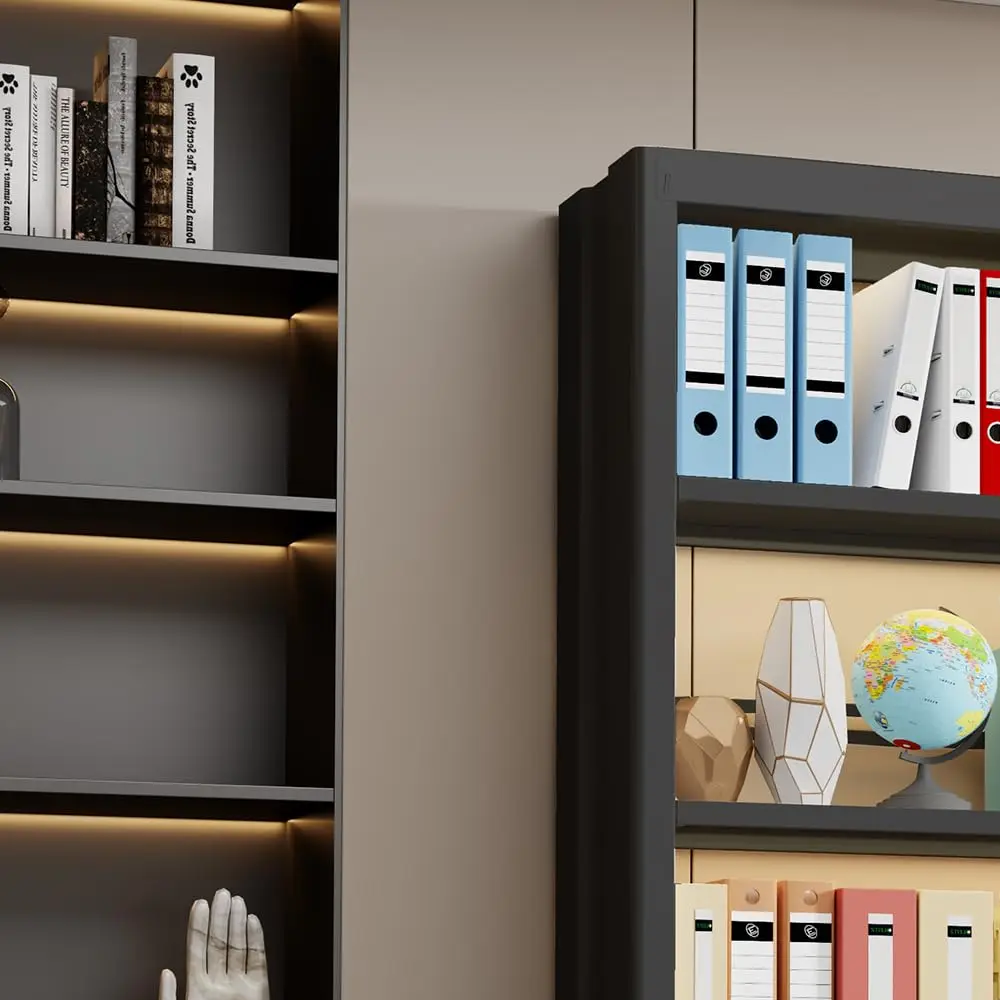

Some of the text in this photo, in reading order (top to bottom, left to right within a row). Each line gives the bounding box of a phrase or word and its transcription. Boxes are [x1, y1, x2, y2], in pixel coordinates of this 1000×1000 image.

[60, 97, 70, 188] THE ALLURE OF BEAUTY
